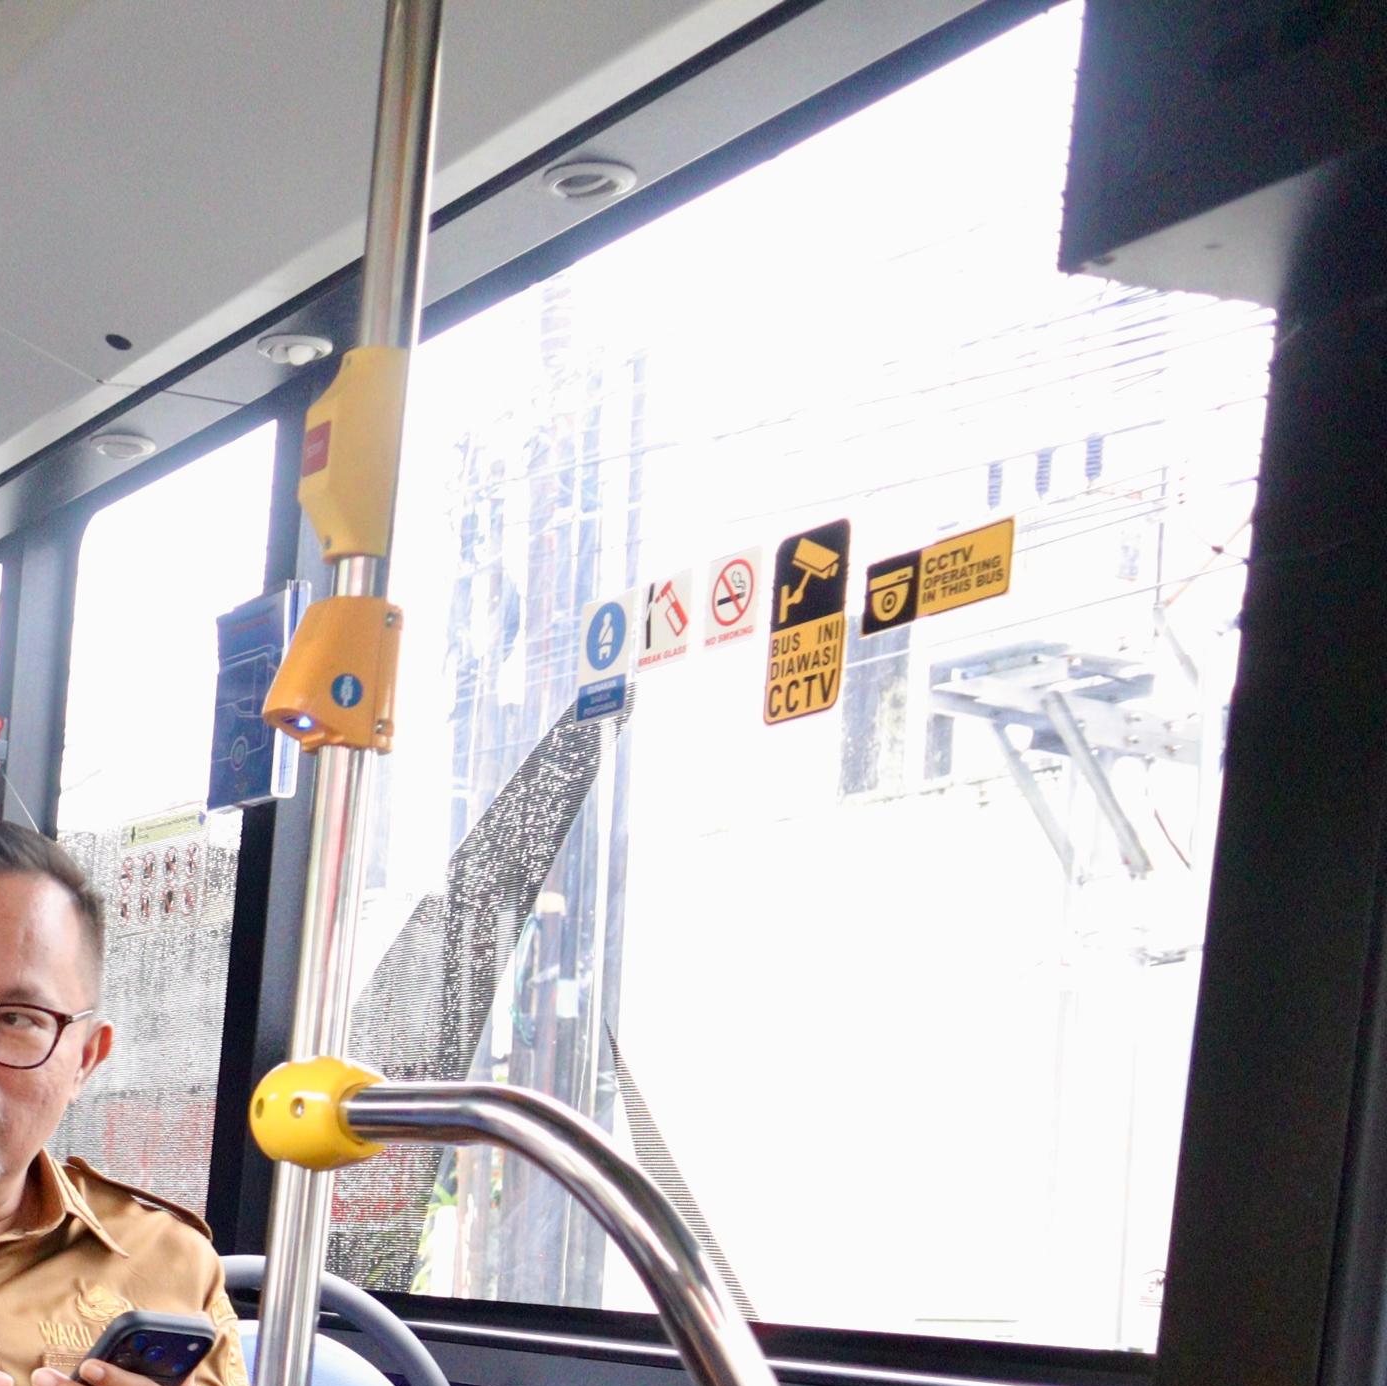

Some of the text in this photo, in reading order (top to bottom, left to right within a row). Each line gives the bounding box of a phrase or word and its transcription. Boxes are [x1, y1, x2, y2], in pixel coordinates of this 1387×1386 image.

[923, 555, 1001, 590] OPERATING
[925, 544, 973, 574] CCTV
[922, 568, 1003, 604] IN THIS BUS
[718, 625, 754, 643] SMOKING
[771, 620, 840, 658] BUS INI
[637, 645, 687, 667] BREAK GLASS
[770, 644, 837, 681] DIAWASI
[768, 669, 836, 718] CCTV
